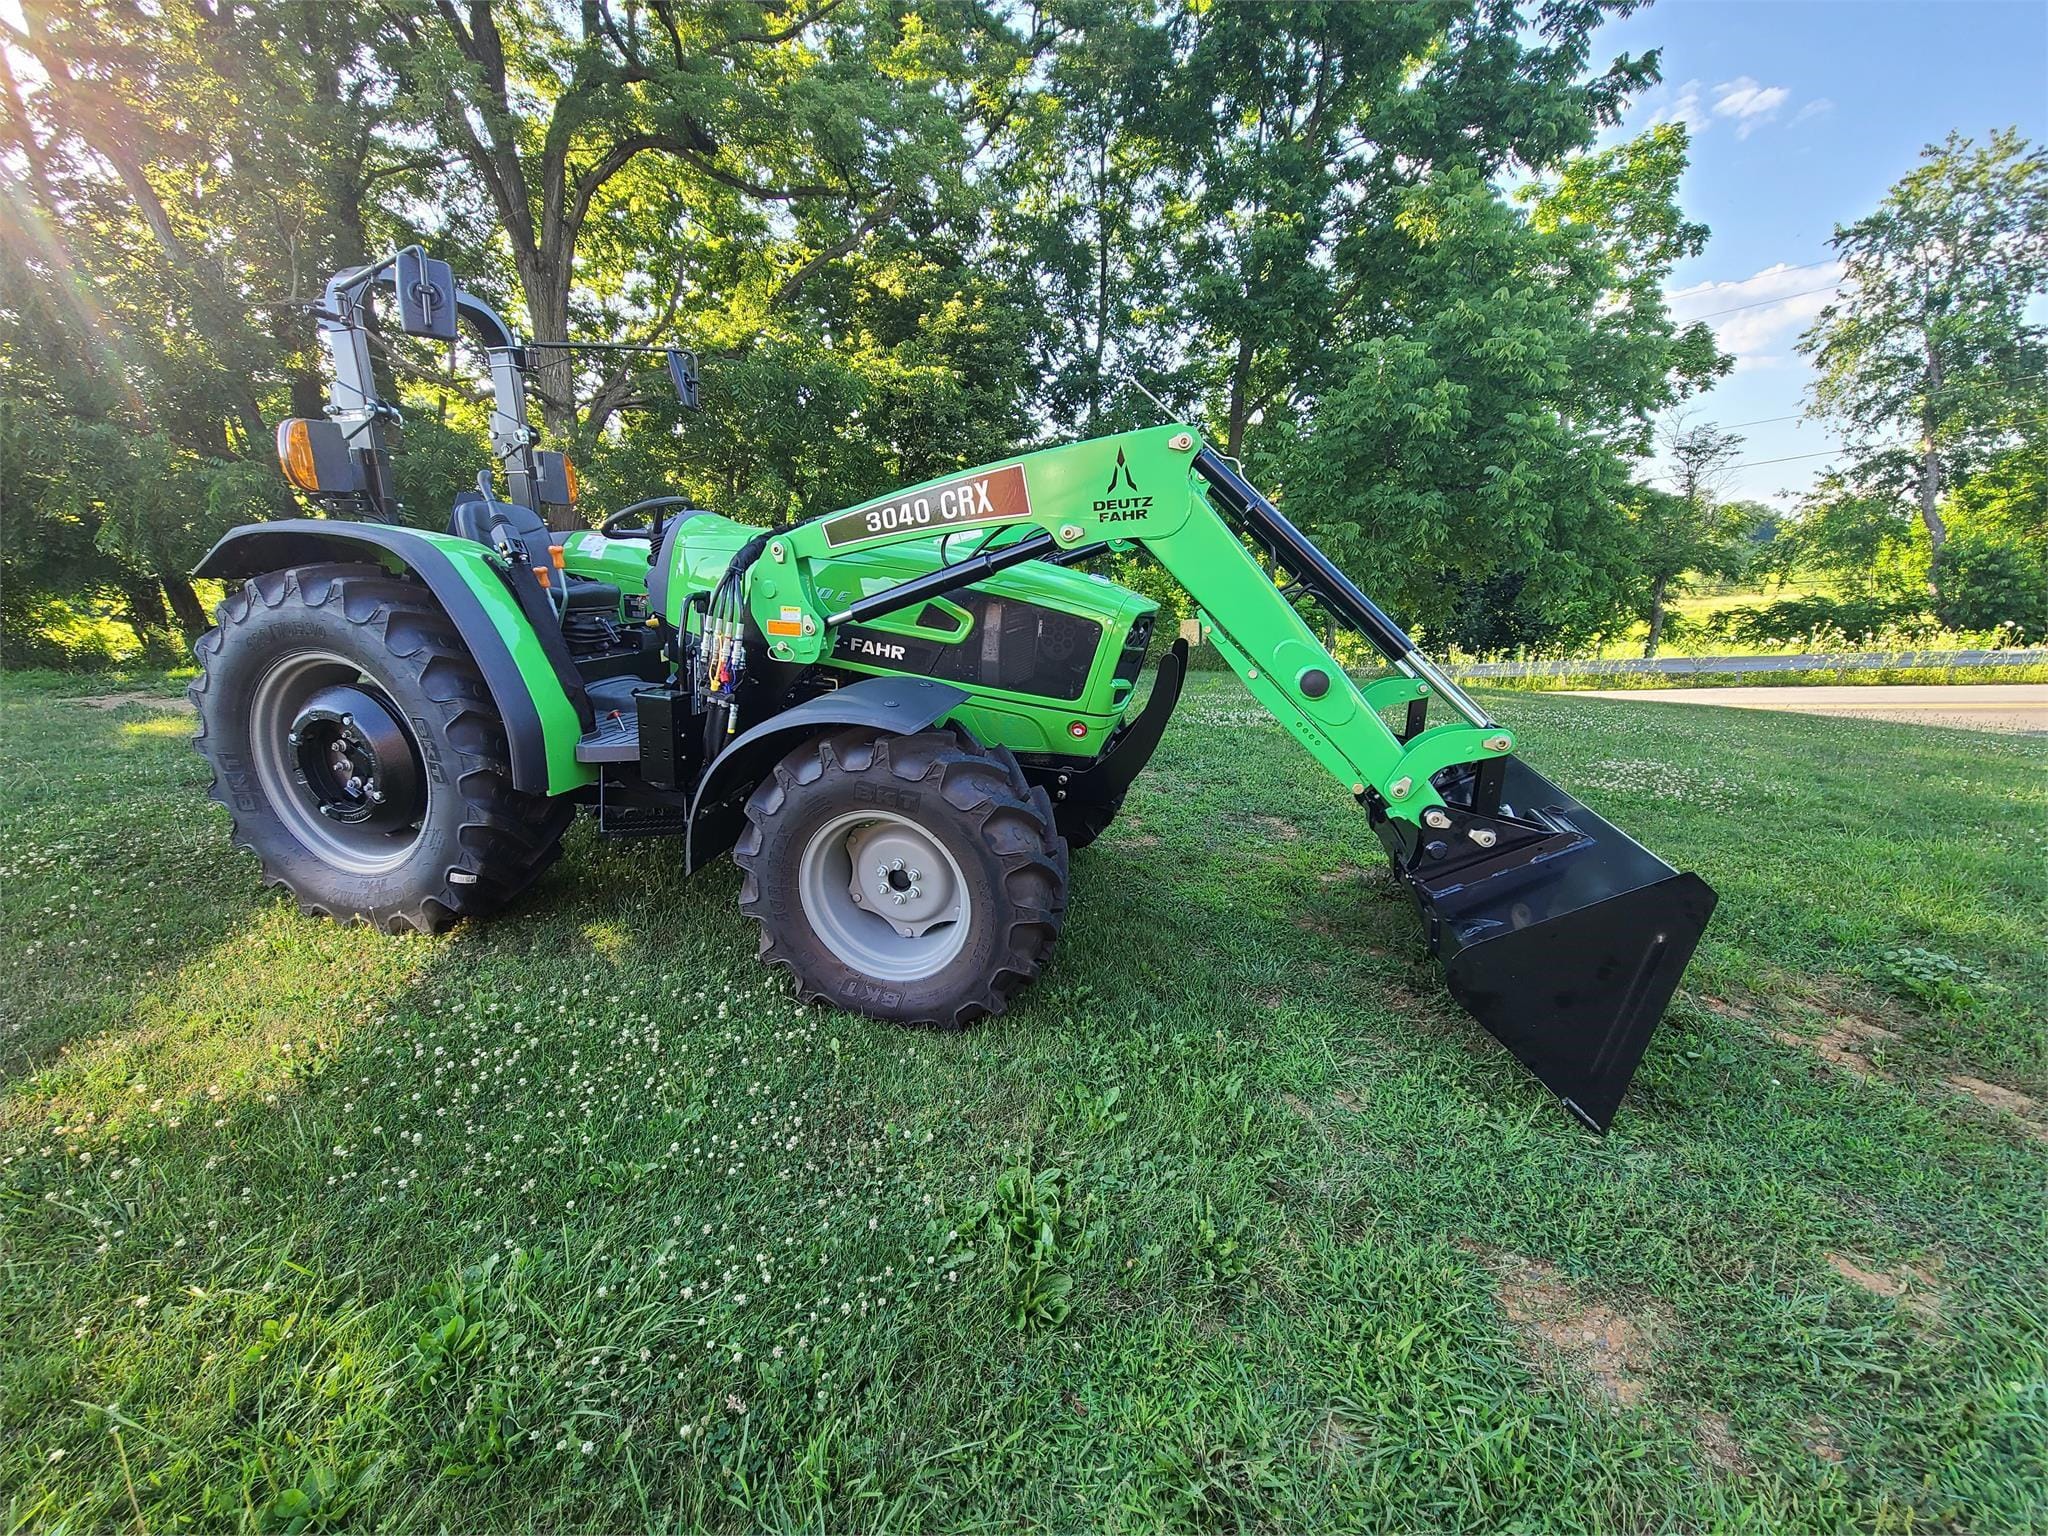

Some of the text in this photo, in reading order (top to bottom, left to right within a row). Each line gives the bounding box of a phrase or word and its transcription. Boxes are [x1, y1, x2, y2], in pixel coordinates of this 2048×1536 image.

[865, 479, 994, 532] 3040 CRX
[1093, 496, 1154, 511] DEUTZ
[1099, 509, 1148, 523] FAHR
[841, 981, 902, 1009] BKT
